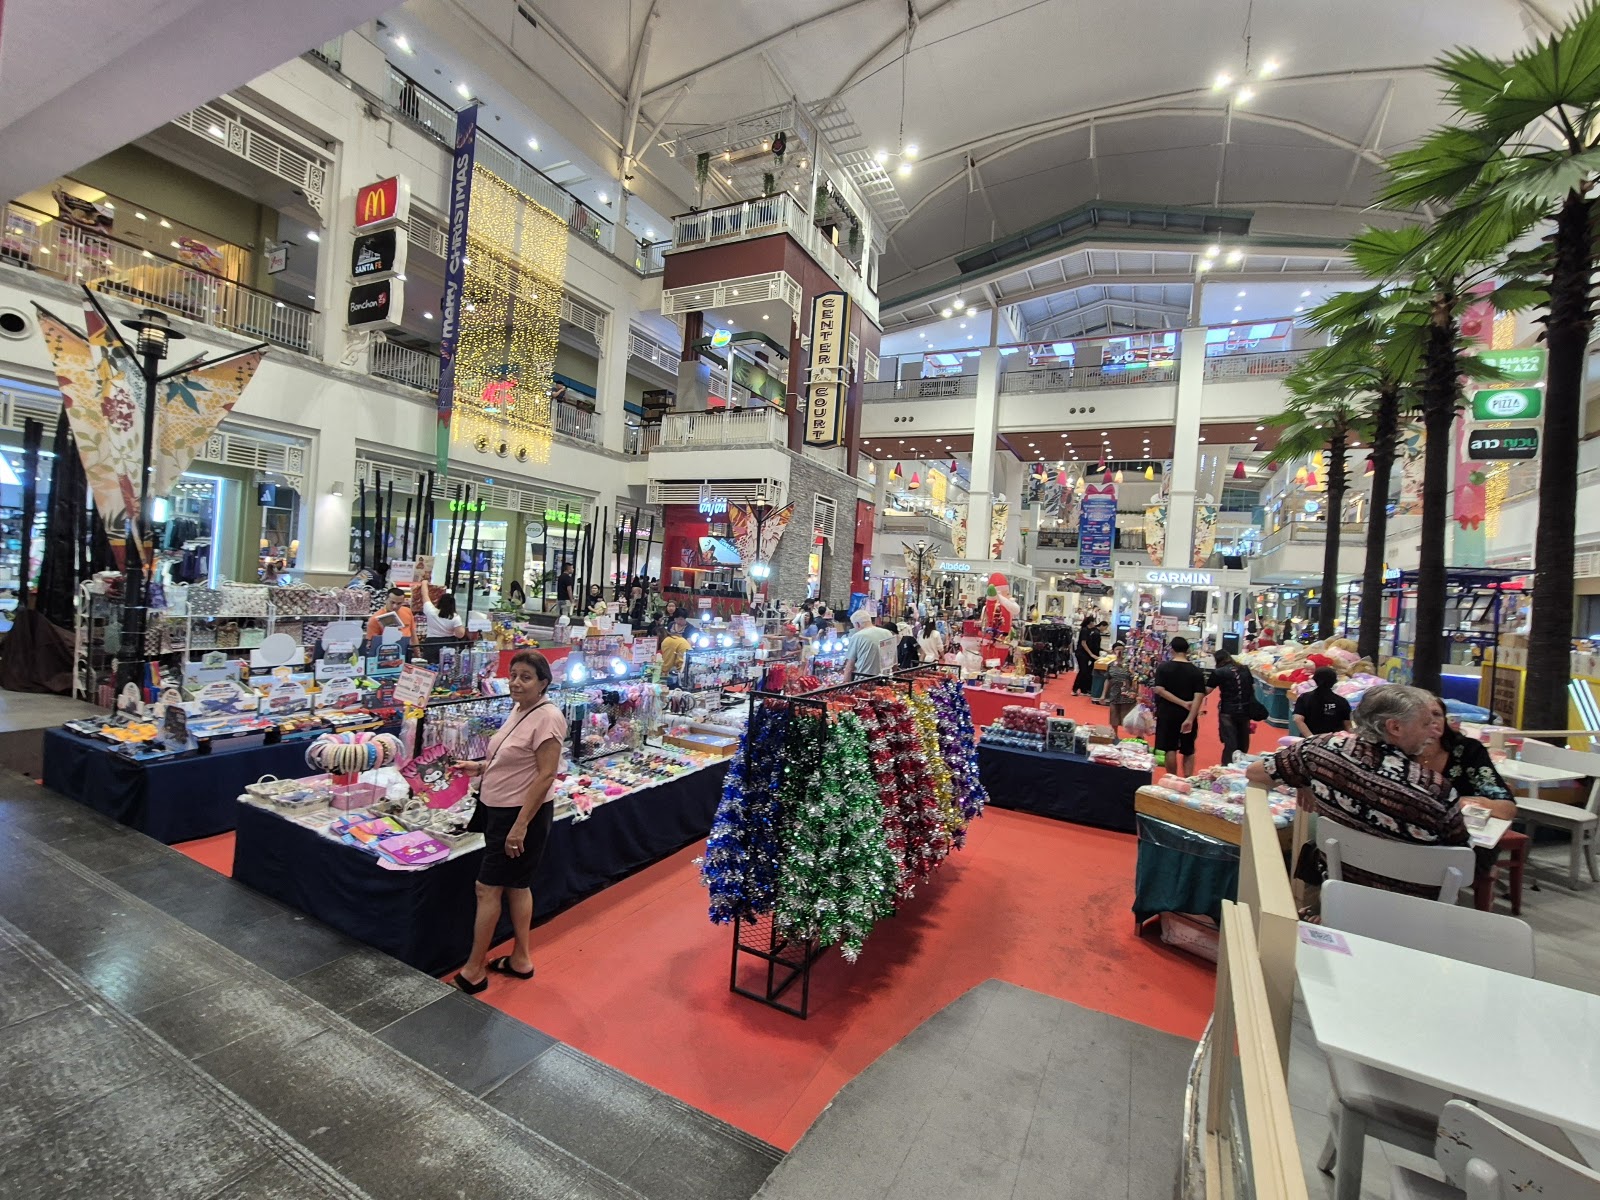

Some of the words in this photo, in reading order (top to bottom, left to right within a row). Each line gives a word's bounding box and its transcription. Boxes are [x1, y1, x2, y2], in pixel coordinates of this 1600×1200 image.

[449, 153, 469, 273] CHRISTMAS
[355, 262, 375, 274] SANTA
[350, 299, 378, 312] Bonchon
[818, 298, 836, 365] CENTER
[1492, 399, 1520, 409] PIZZA
[812, 387, 829, 440] COURT
[939, 562, 971, 571] Albédo
[1146, 571, 1212, 584] GARMIN
